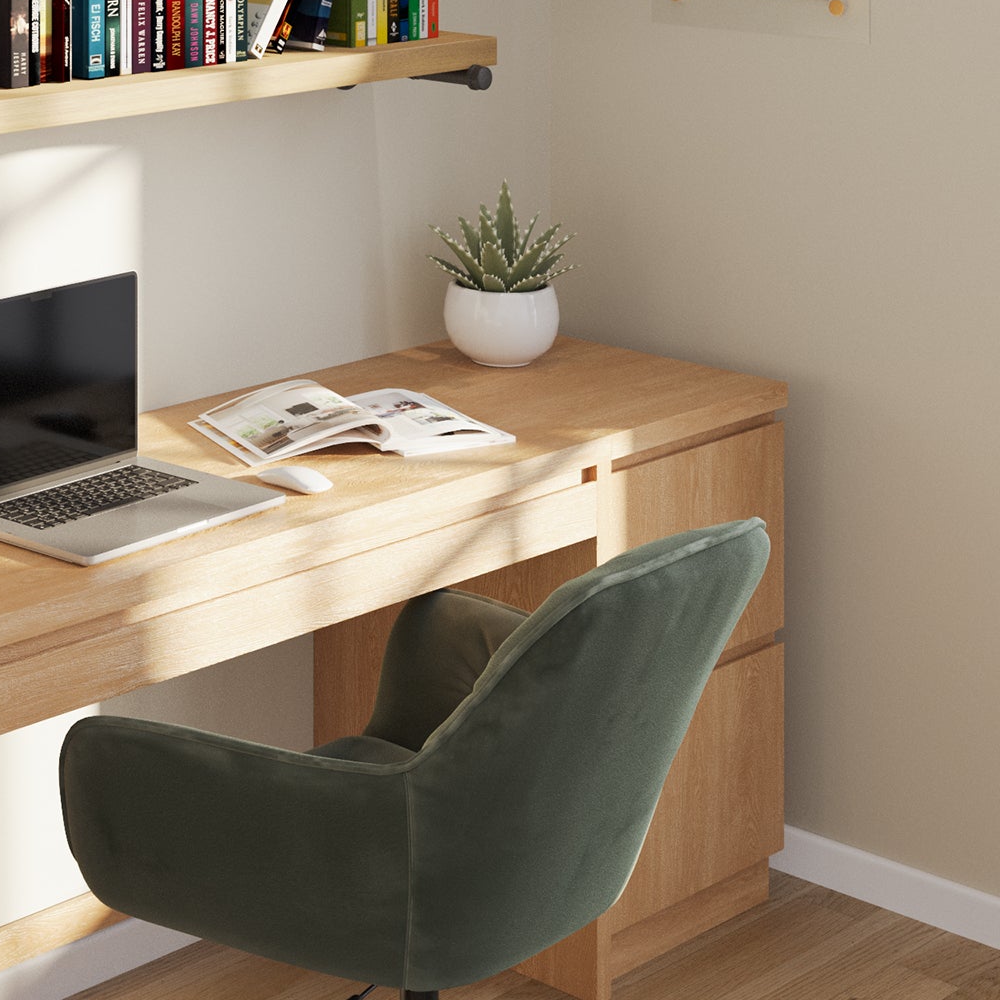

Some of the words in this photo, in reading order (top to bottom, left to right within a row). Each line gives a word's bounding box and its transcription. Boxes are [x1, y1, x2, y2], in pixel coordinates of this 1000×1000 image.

[91, 4, 101, 14] EJ
[171, 1, 181, 41] RANDOLPH
[190, 3, 199, 24] DAWN
[206, 0, 215, 29] NANCY
[91, 15, 101, 42] FISCH
[206, 30, 215, 38] J.
[172, 43, 180, 56] KAY
[190, 27, 199, 62] JOHNSON
[206, 39, 215, 63] PRICE
